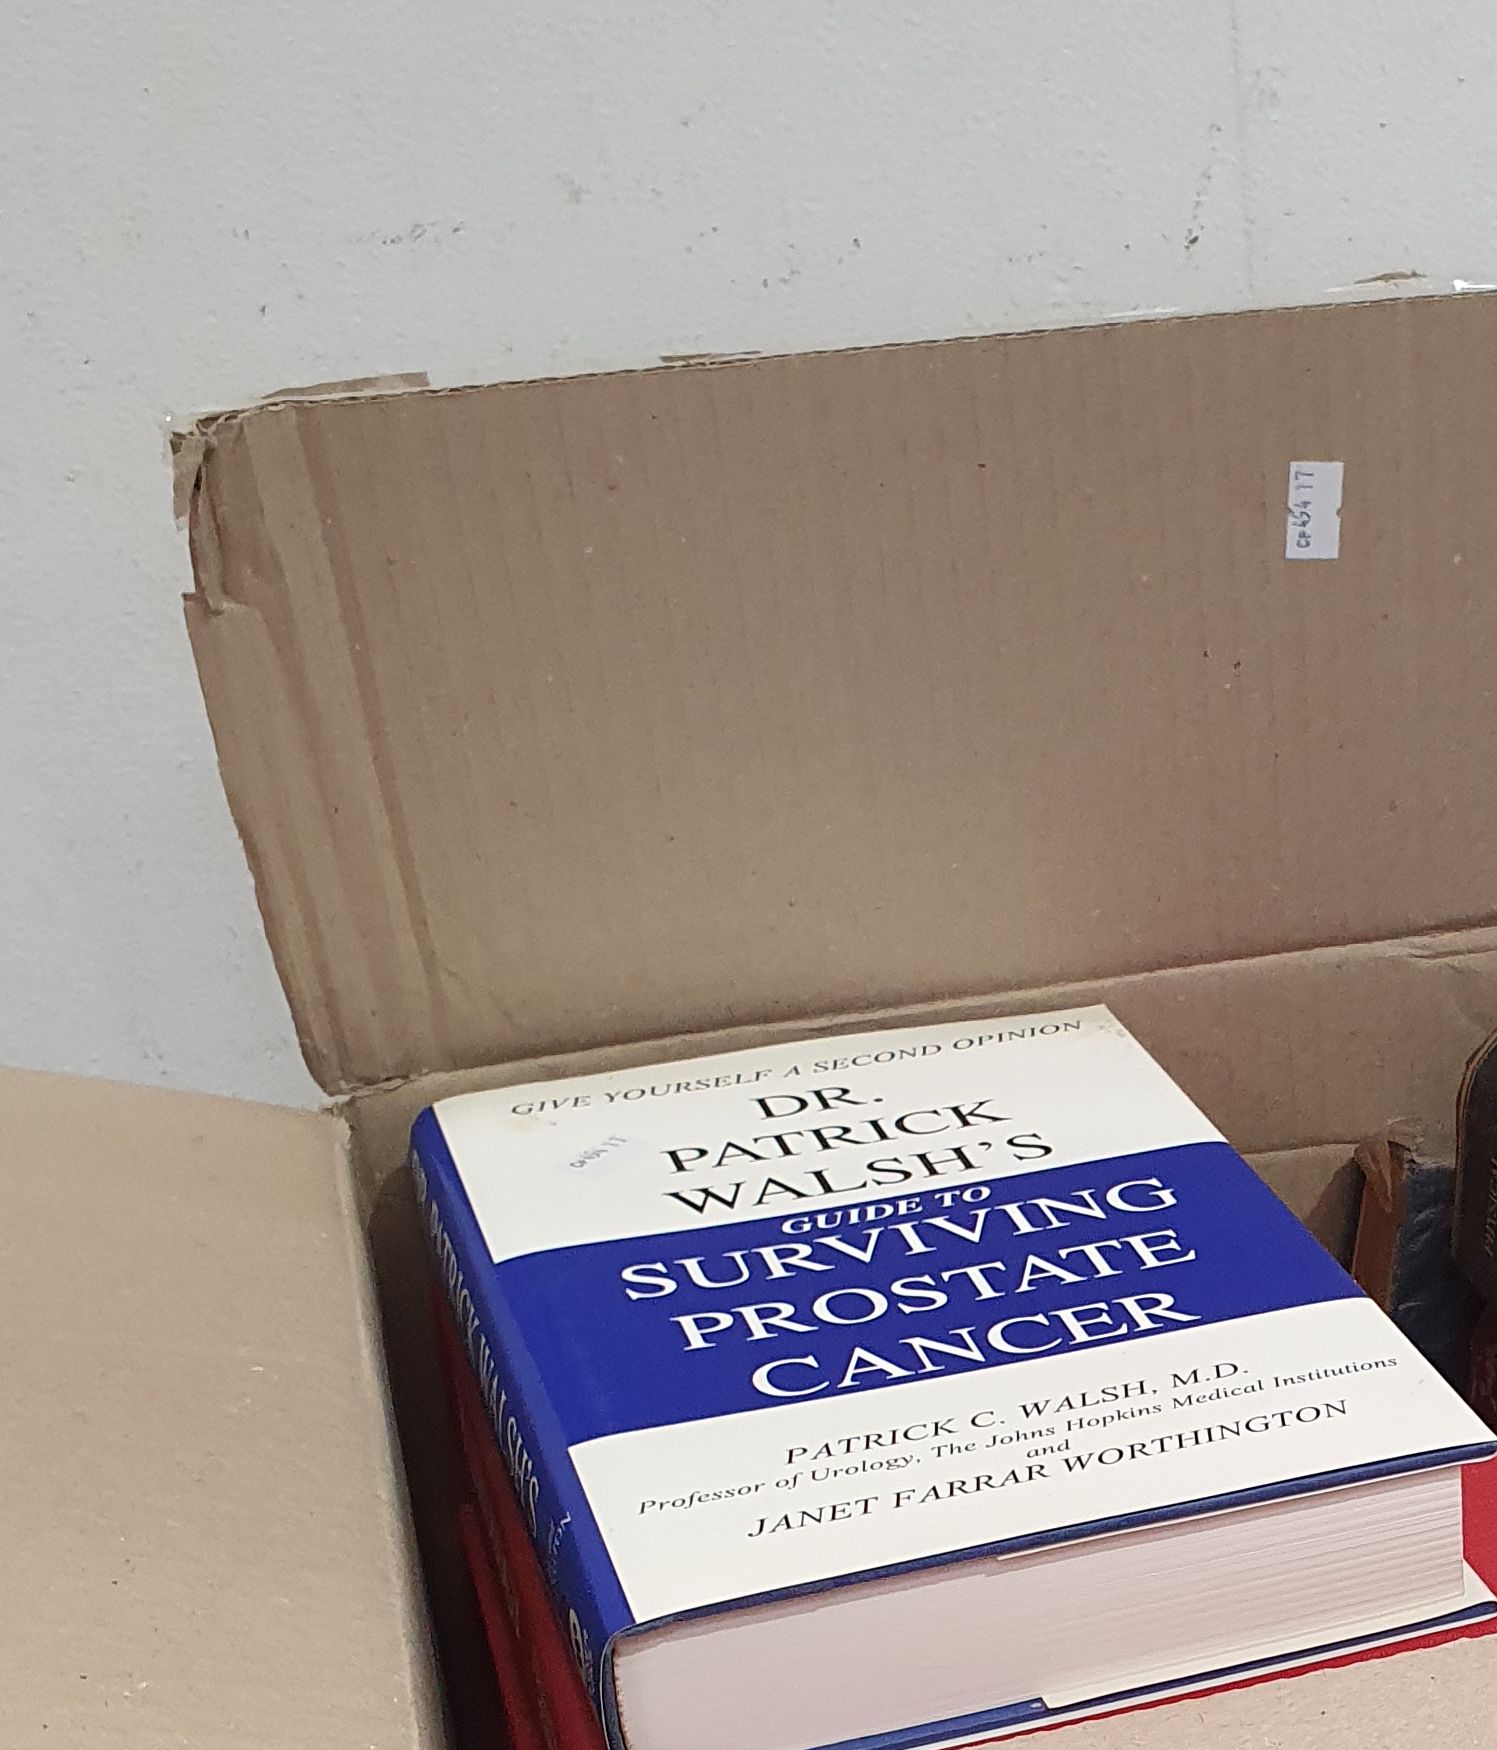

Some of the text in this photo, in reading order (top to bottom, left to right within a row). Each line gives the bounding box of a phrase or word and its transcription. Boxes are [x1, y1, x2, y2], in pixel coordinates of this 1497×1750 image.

[511, 1020, 1082, 1116] GIVE YOURSELF A SECOND OPINION
[750, 1086, 885, 1120] DR.
[660, 1098, 1013, 1174] PATRICK
[661, 1133, 1053, 1215] WALSH'S
[620, 1175, 1179, 1300] SURVIVING
[781, 1185, 992, 1235] GUIDE TO
[670, 1228, 1197, 1351] PROSTATE
[751, 1291, 1202, 1398] CANCER
[638, 1357, 1399, 1515] Professor of Urology, The Johns Hopkins Medical Institutions
[784, 1361, 1250, 1465] PATRICK C. WALSH, M.D.
[1026, 1439, 1072, 1459] and
[747, 1399, 1348, 1537] JANET FARRAR WORTHINGTON
